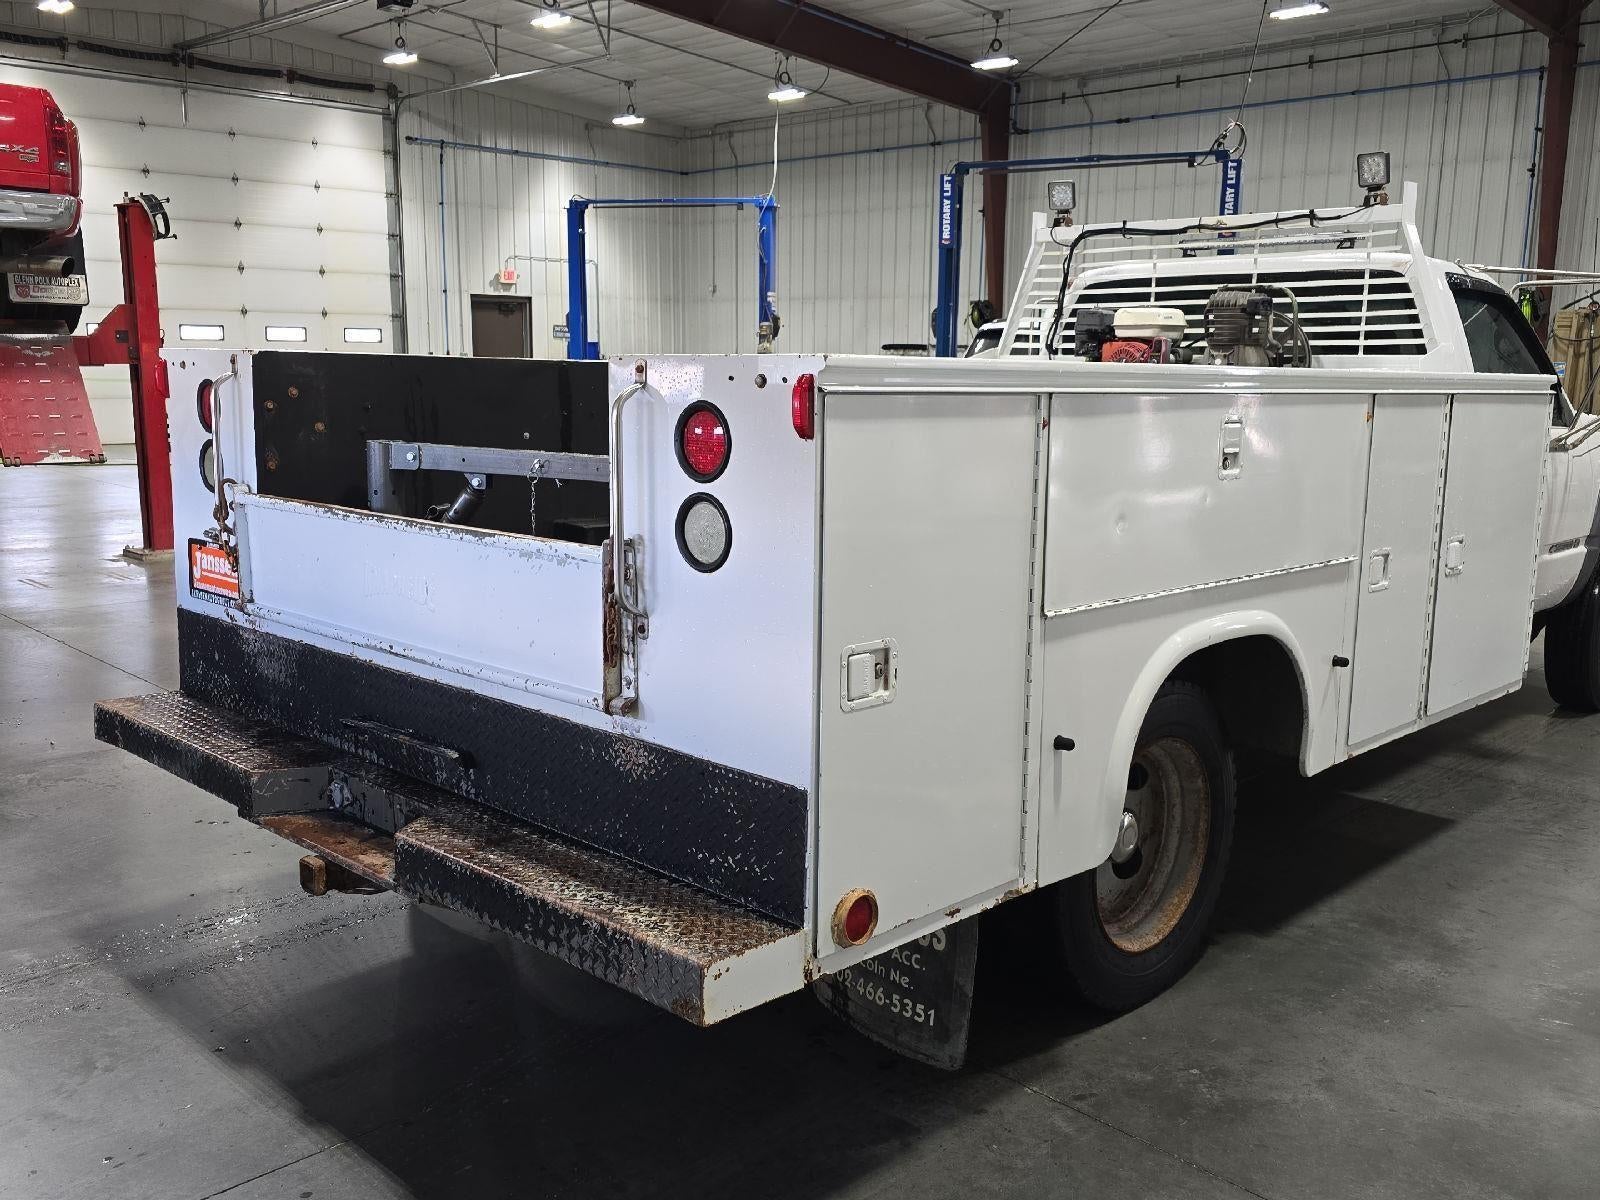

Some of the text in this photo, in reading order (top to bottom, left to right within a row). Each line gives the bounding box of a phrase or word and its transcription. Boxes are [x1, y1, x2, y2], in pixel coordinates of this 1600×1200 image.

[942, 174, 952, 238] ROTARY LIFT
[1224, 162, 1237, 216] TARY LIFT
[14, 275, 80, 287] GLENN POLK AUTOPLEX
[891, 946, 926, 971] ACC.
[834, 968, 936, 1027] 02-466-5351
[889, 967, 914, 990] Ne.
